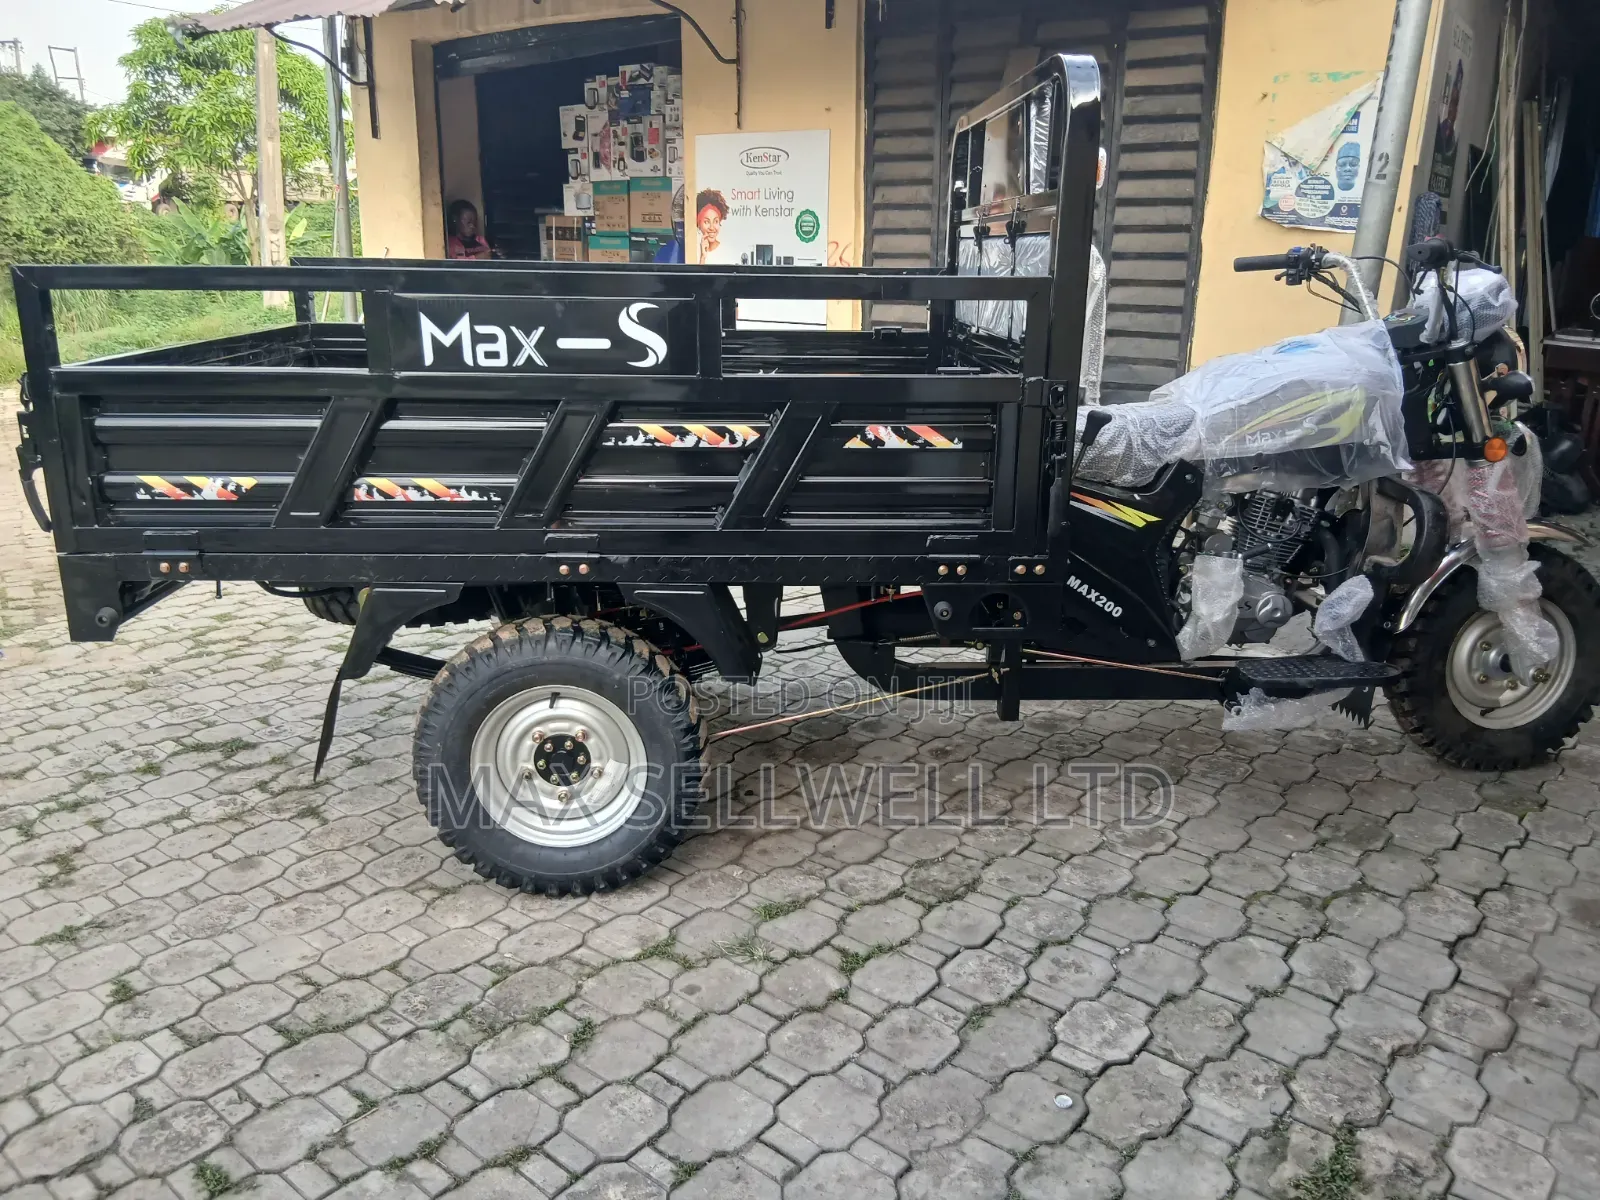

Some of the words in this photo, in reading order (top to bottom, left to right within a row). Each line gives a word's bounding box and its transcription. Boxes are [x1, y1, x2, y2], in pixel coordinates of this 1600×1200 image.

[745, 152, 781, 163] KenStar
[731, 188, 761, 201] Smart
[764, 187, 795, 203] Living
[731, 205, 752, 217] with
[754, 204, 795, 217] Kenstar
[1066, 575, 1123, 618] MAX200
